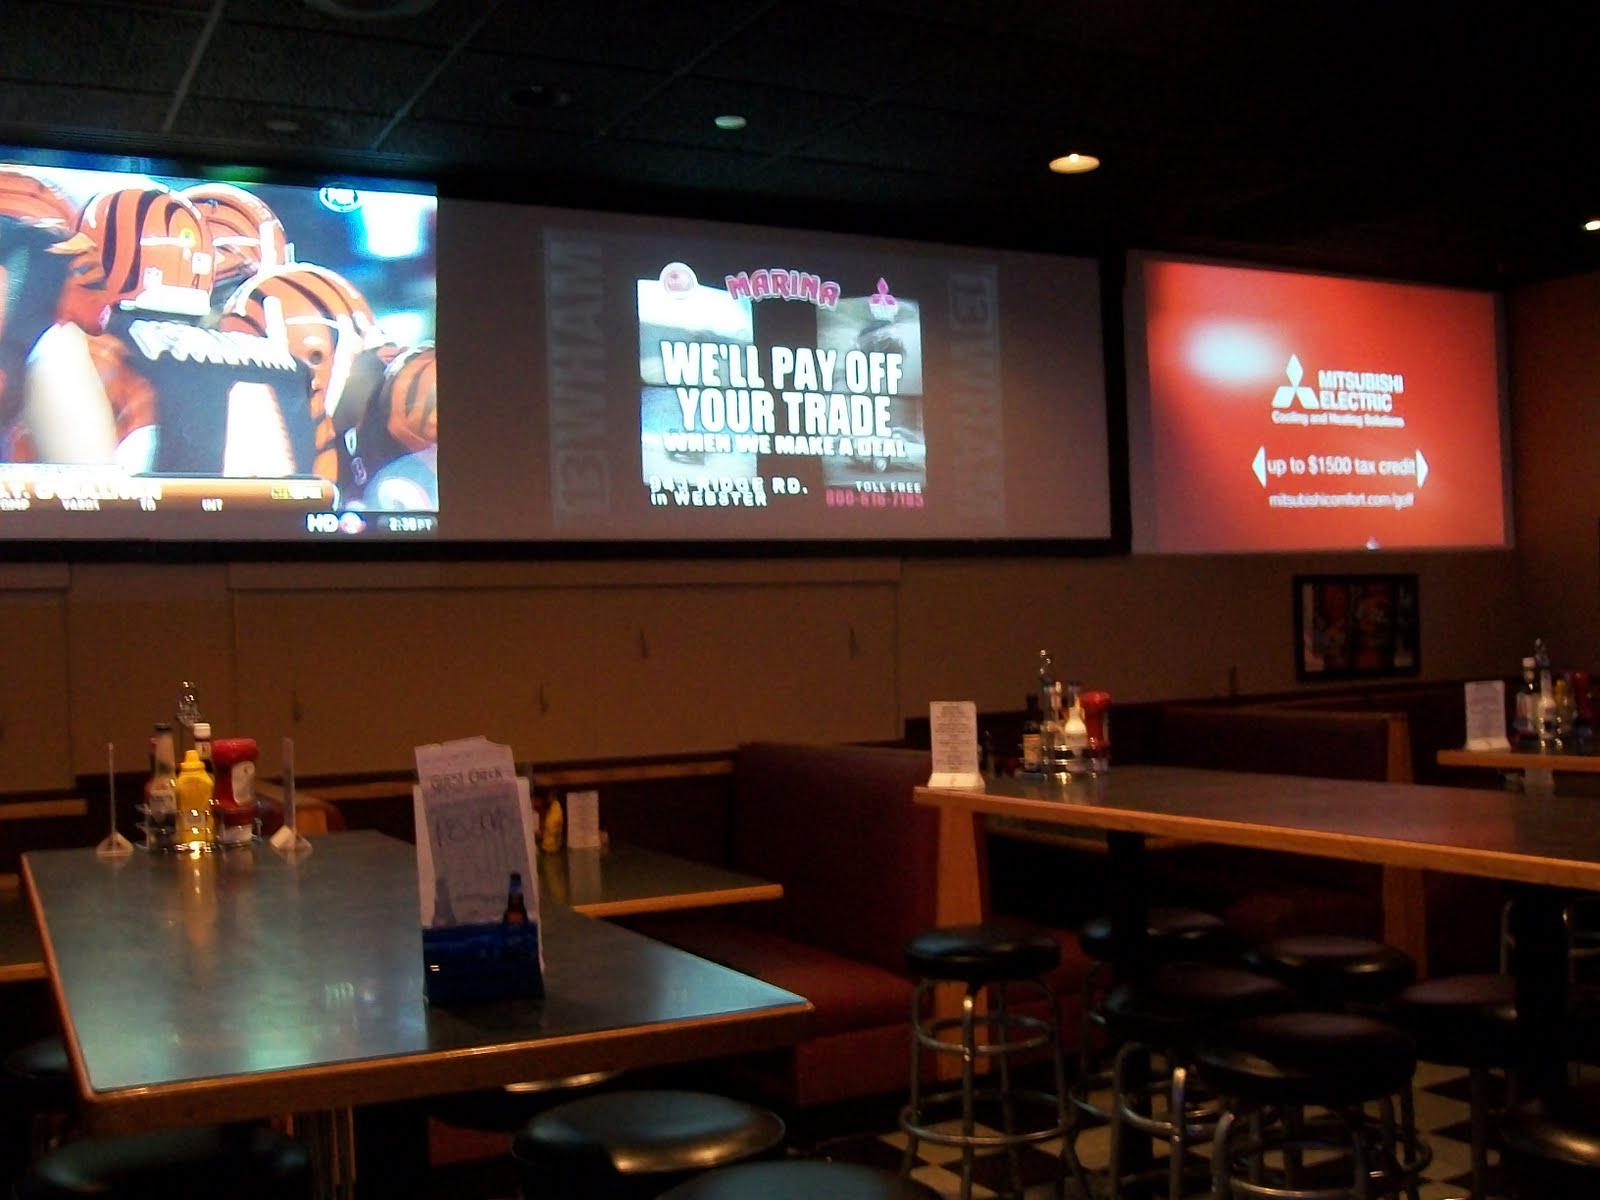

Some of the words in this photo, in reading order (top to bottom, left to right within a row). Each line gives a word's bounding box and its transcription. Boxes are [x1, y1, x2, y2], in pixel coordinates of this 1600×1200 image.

[724, 268, 841, 310] MARINA
[660, 341, 765, 388] WE'LL
[771, 346, 837, 392] PAY
[845, 350, 903, 395] OFF
[1318, 370, 1404, 393] MITSUBISHI
[677, 387, 775, 433] YOUR
[782, 391, 892, 437] TRADE
[1319, 390, 1393, 412] ELECTRIC
[664, 432, 731, 454] WHEN
[735, 433, 772, 455] WE
[775, 435, 836, 456] MAKE
[838, 437, 854, 457] A
[1267, 459, 1287, 477] up
[1290, 456, 1305, 475] to
[1308, 454, 1353, 475] $1500
[1354, 457, 1377, 475] tax
[1378, 457, 1416, 476] credit
[772, 477, 808, 494] RD.
[855, 480, 887, 493] TOLL
[890, 482, 922, 494] FREE
[202, 498, 223, 511] INT
[674, 491, 767, 507] WEBSTER
[306, 513, 339, 532] HD
